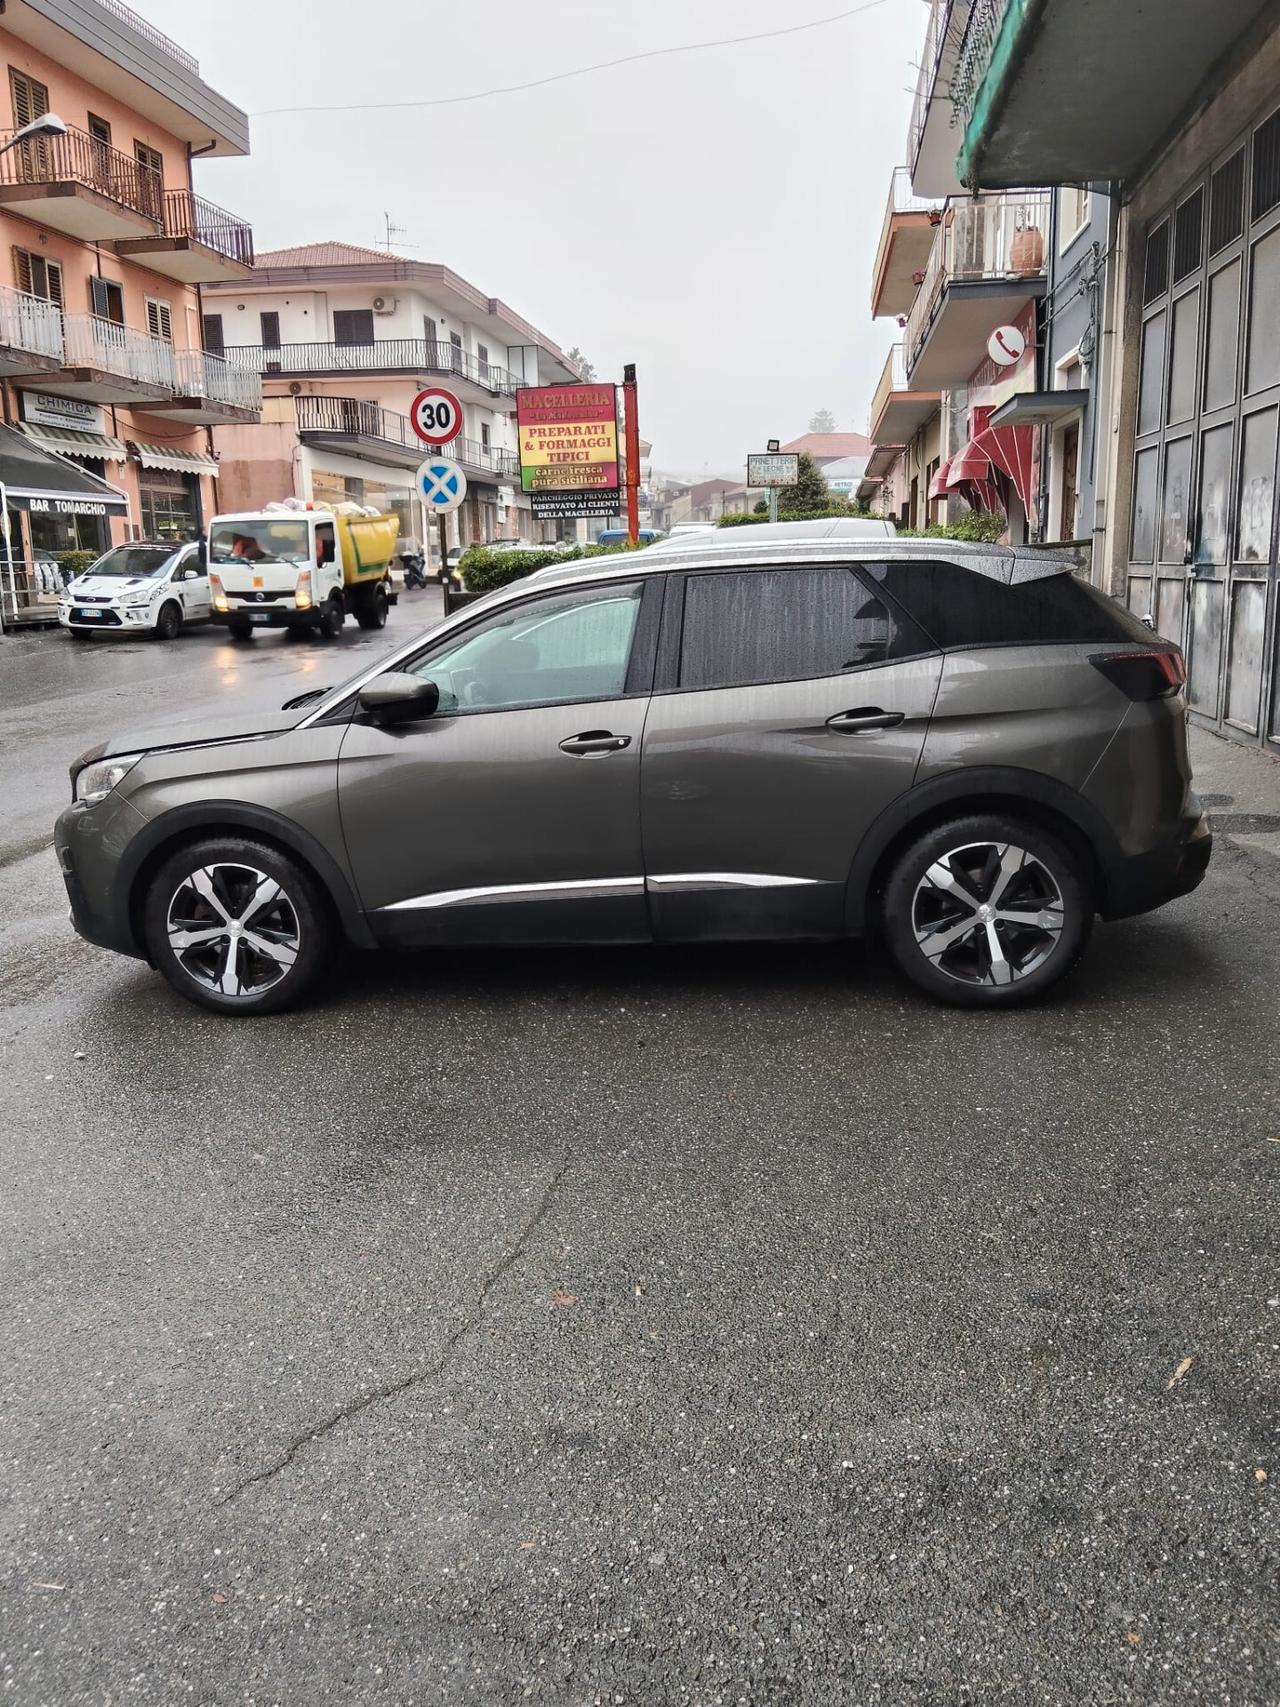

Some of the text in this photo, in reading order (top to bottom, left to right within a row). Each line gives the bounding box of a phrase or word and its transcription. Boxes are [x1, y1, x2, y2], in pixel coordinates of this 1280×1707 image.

[37, 395, 92, 415] CHIMICA
[522, 392, 609, 409] MACELLERIA
[422, 403, 450, 430] 30
[528, 424, 606, 438] PREPARATI
[524, 437, 612, 451] & FORMAGGI
[547, 451, 590, 463] TIPICI
[535, 465, 603, 476] carne fresca
[532, 474, 608, 488] pura siciliana
[532, 492, 618, 502] PARCHEGGIO PRIVATO
[30, 499, 106, 515] BAR TOMARCHIO
[532, 500, 619, 510] RISERVATO AI CLIENTI
[537, 508, 614, 518] DELLA MACELLERIA
